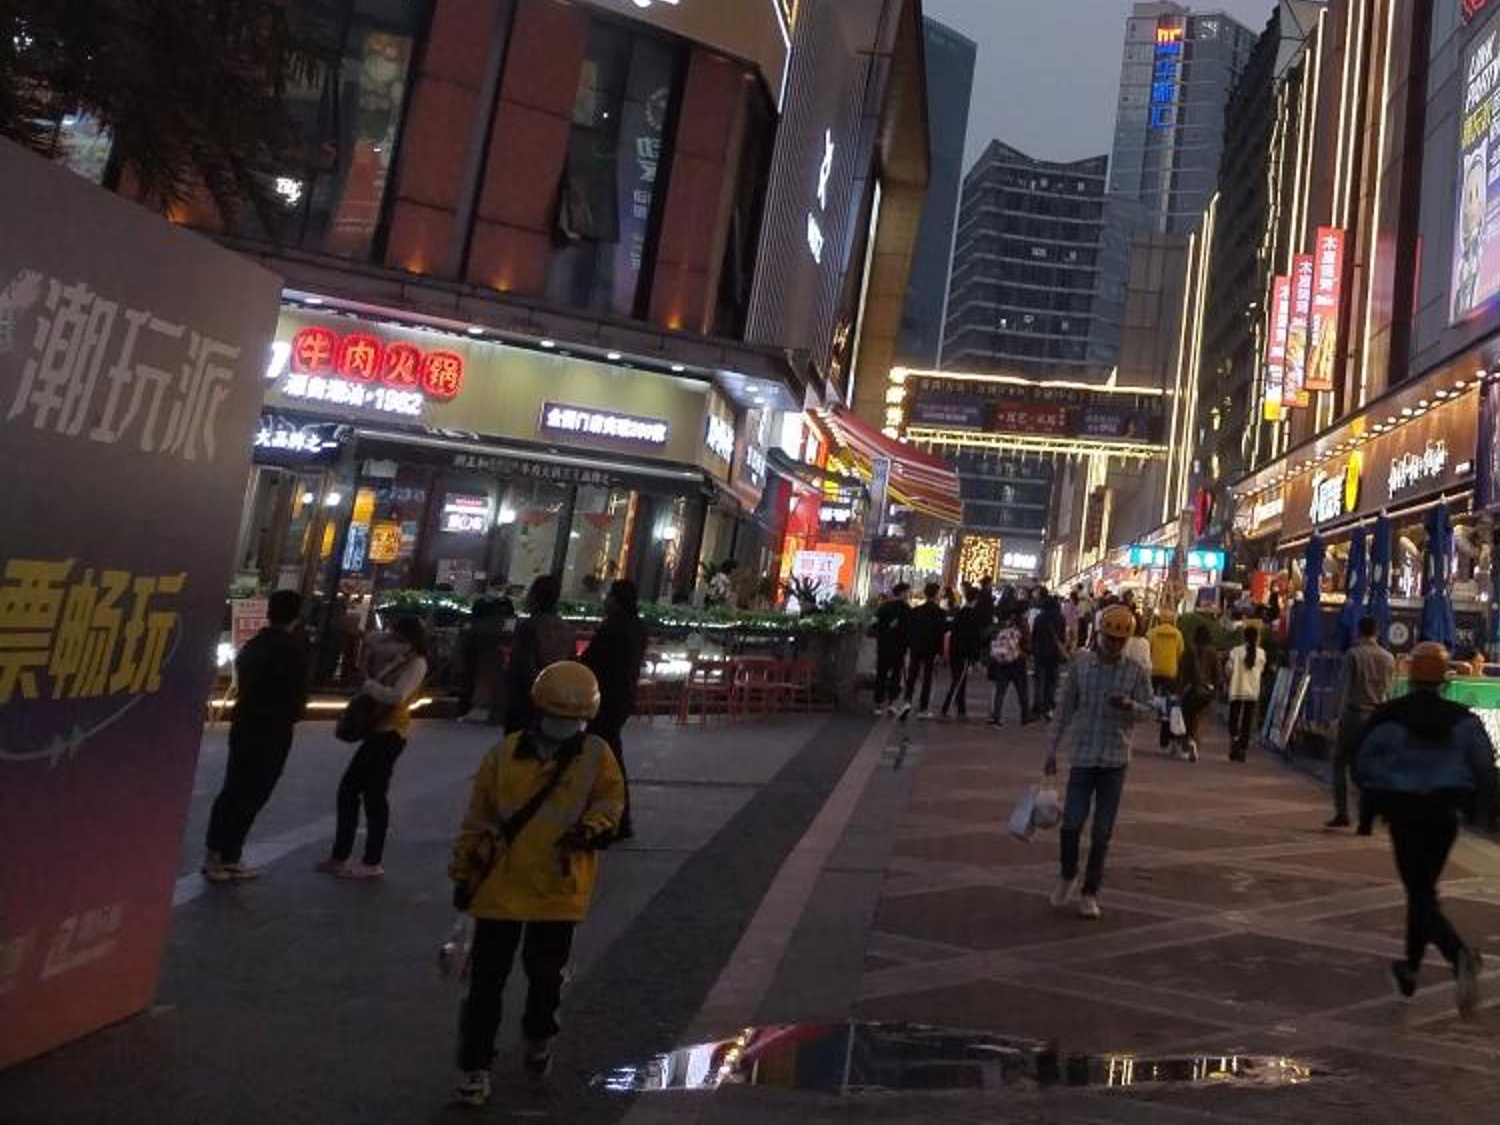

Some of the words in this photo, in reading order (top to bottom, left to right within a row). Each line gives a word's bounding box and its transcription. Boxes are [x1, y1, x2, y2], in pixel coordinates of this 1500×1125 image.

[7, 278, 241, 463] 潮玩派
[294, 327, 463, 394] 牛肉火锅
